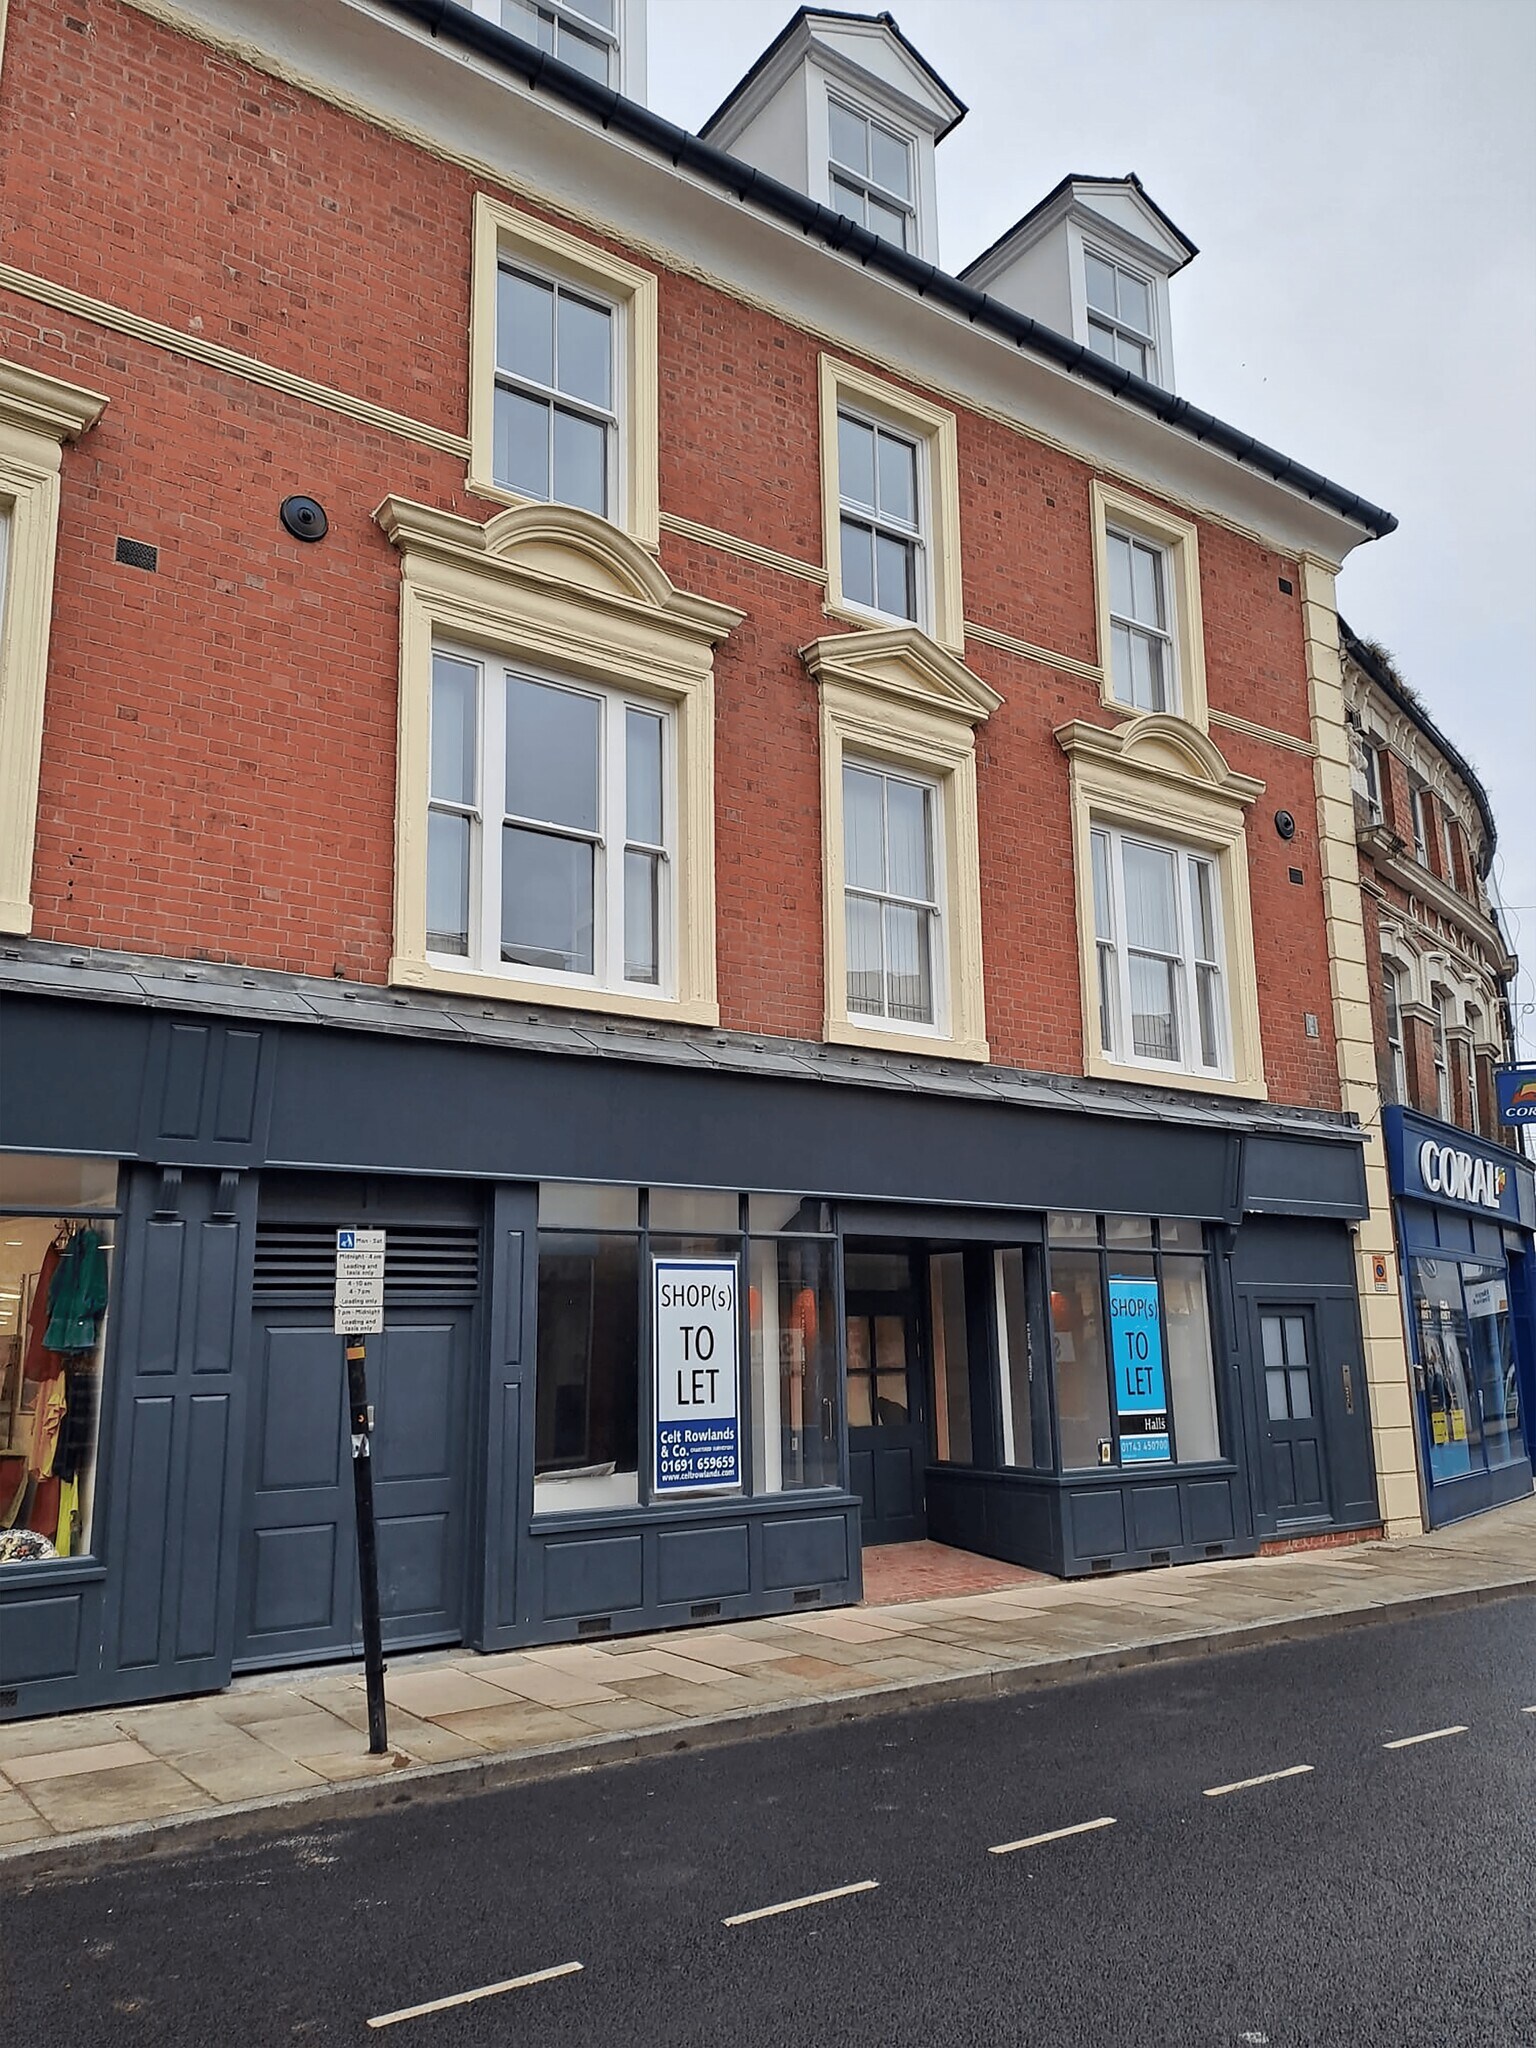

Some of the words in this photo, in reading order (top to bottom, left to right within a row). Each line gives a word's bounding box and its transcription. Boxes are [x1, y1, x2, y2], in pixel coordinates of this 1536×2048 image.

[1421, 1141, 1500, 1209] CORAL
[661, 1284, 732, 1311] SHOP(s)
[1111, 1299, 1158, 1320] SHOP(s)
[679, 1325, 715, 1361] TO
[1125, 1331, 1148, 1360] TO
[677, 1369, 719, 1405] LET
[1126, 1366, 1153, 1395] LET
[1144, 1417, 1166, 1431] Halls
[660, 1429, 682, 1444] Celt
[684, 1427, 735, 1443] Rowlands
[1121, 1440, 1141, 1452] 01743
[1143, 1439, 1168, 1451] 450700
[661, 1445, 669, 1458] &
[672, 1444, 690, 1457] Co.
[661, 1458, 693, 1473] 01691
[697, 1455, 735, 1470] 659659
[662, 1469, 735, 1482] www.celtrowlands.com
